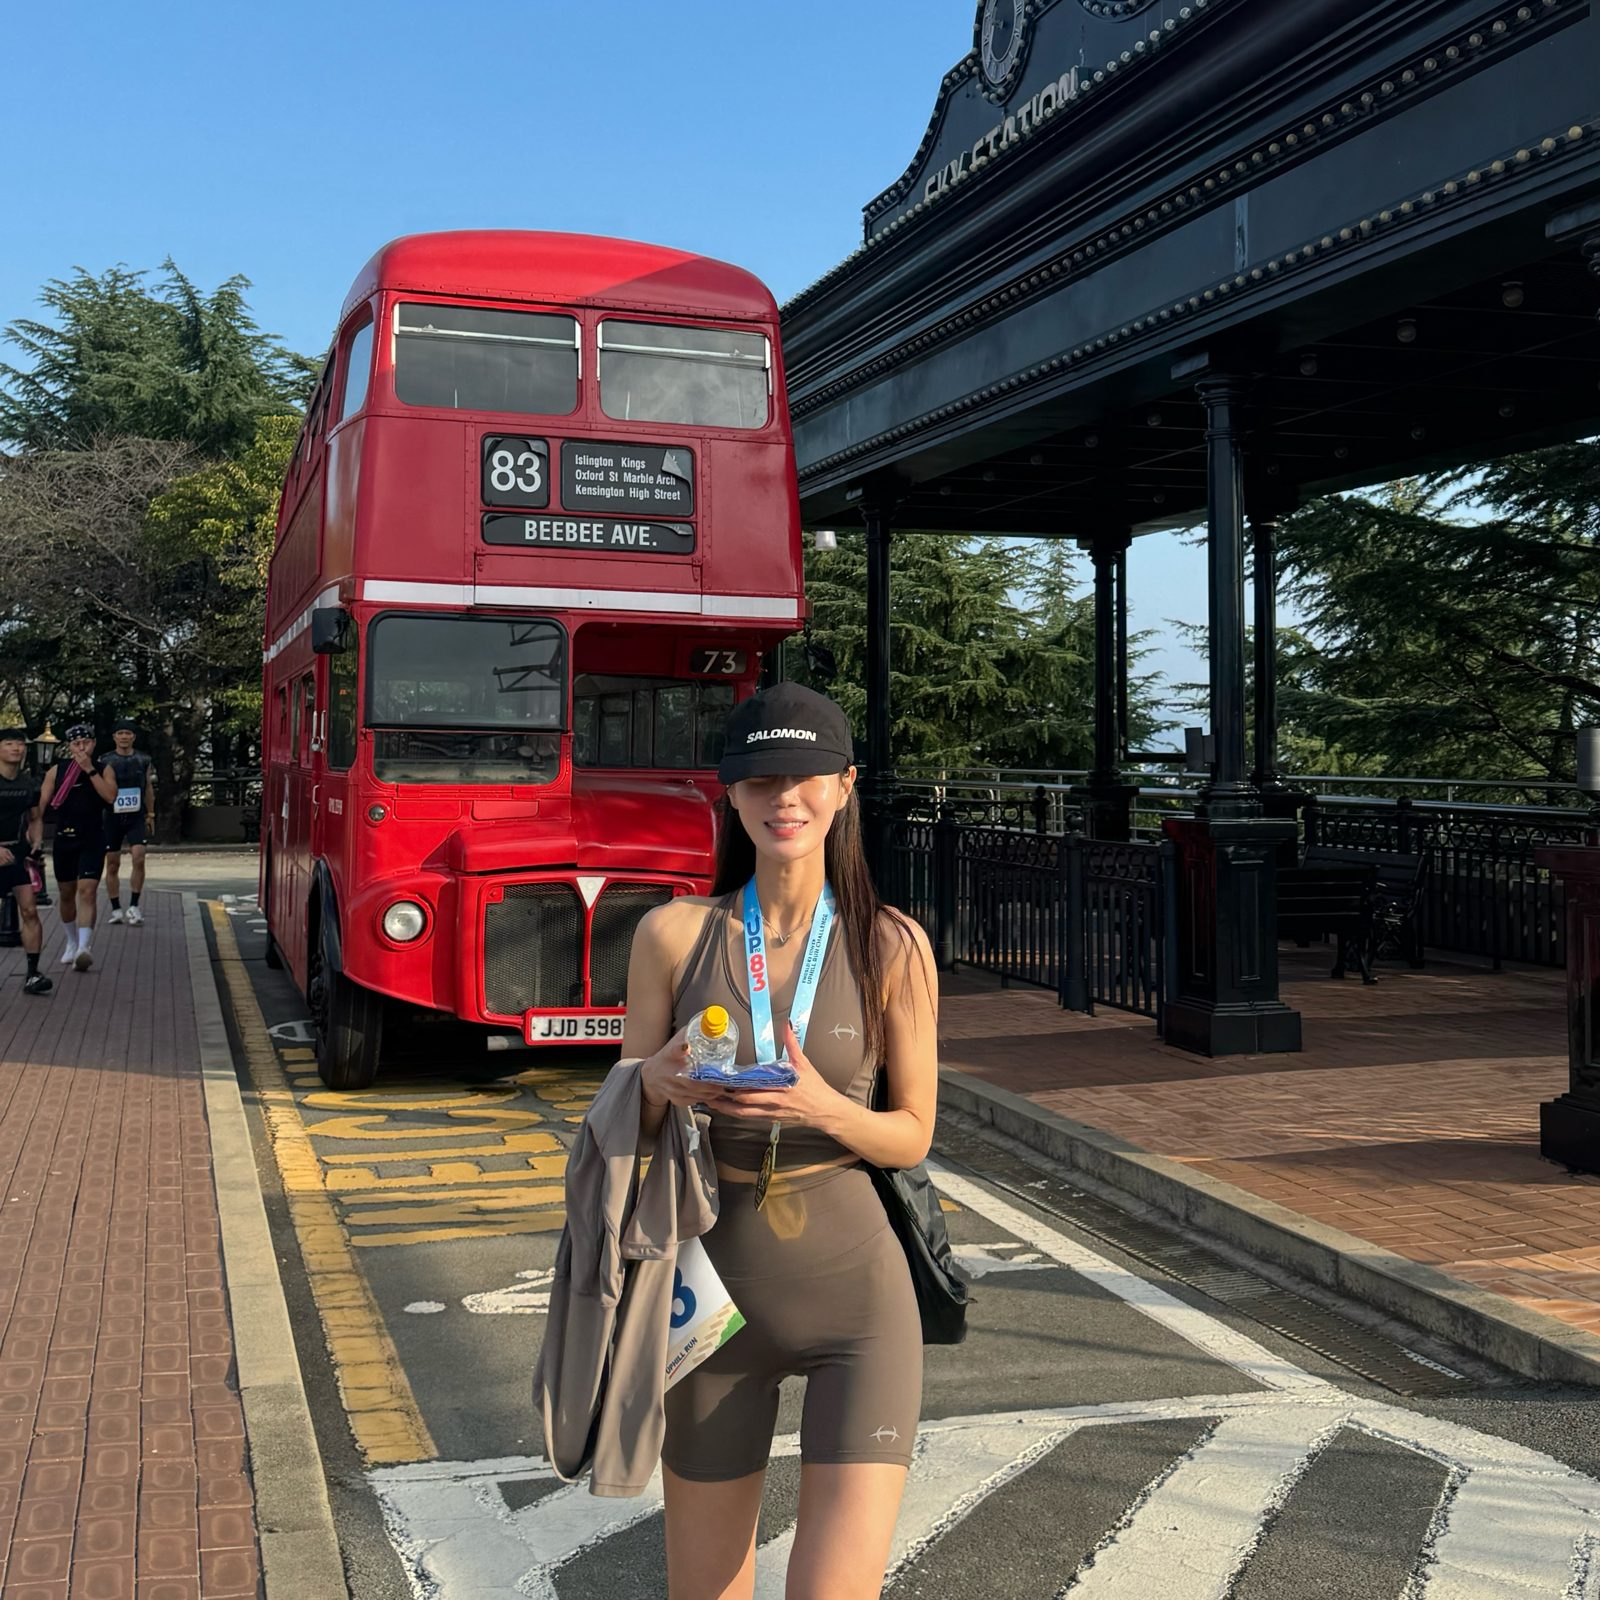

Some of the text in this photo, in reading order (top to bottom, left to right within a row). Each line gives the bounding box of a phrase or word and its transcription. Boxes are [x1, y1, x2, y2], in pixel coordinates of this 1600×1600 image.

[490, 450, 542, 493] 83
[575, 454, 646, 470] Islington Kings
[575, 469, 676, 486] Oxford St Marble Arch
[575, 485, 681, 501] Kensington High Street
[524, 519, 658, 547] BEEBEE AVE.
[703, 650, 737, 674] 73
[746, 728, 817, 744] SALOMON
[750, 953, 767, 992] 83
[540, 1018, 626, 1037] JJD 598
[665, 1352, 685, 1374] UPHILL
[684, 1336, 698, 1352] RUN
